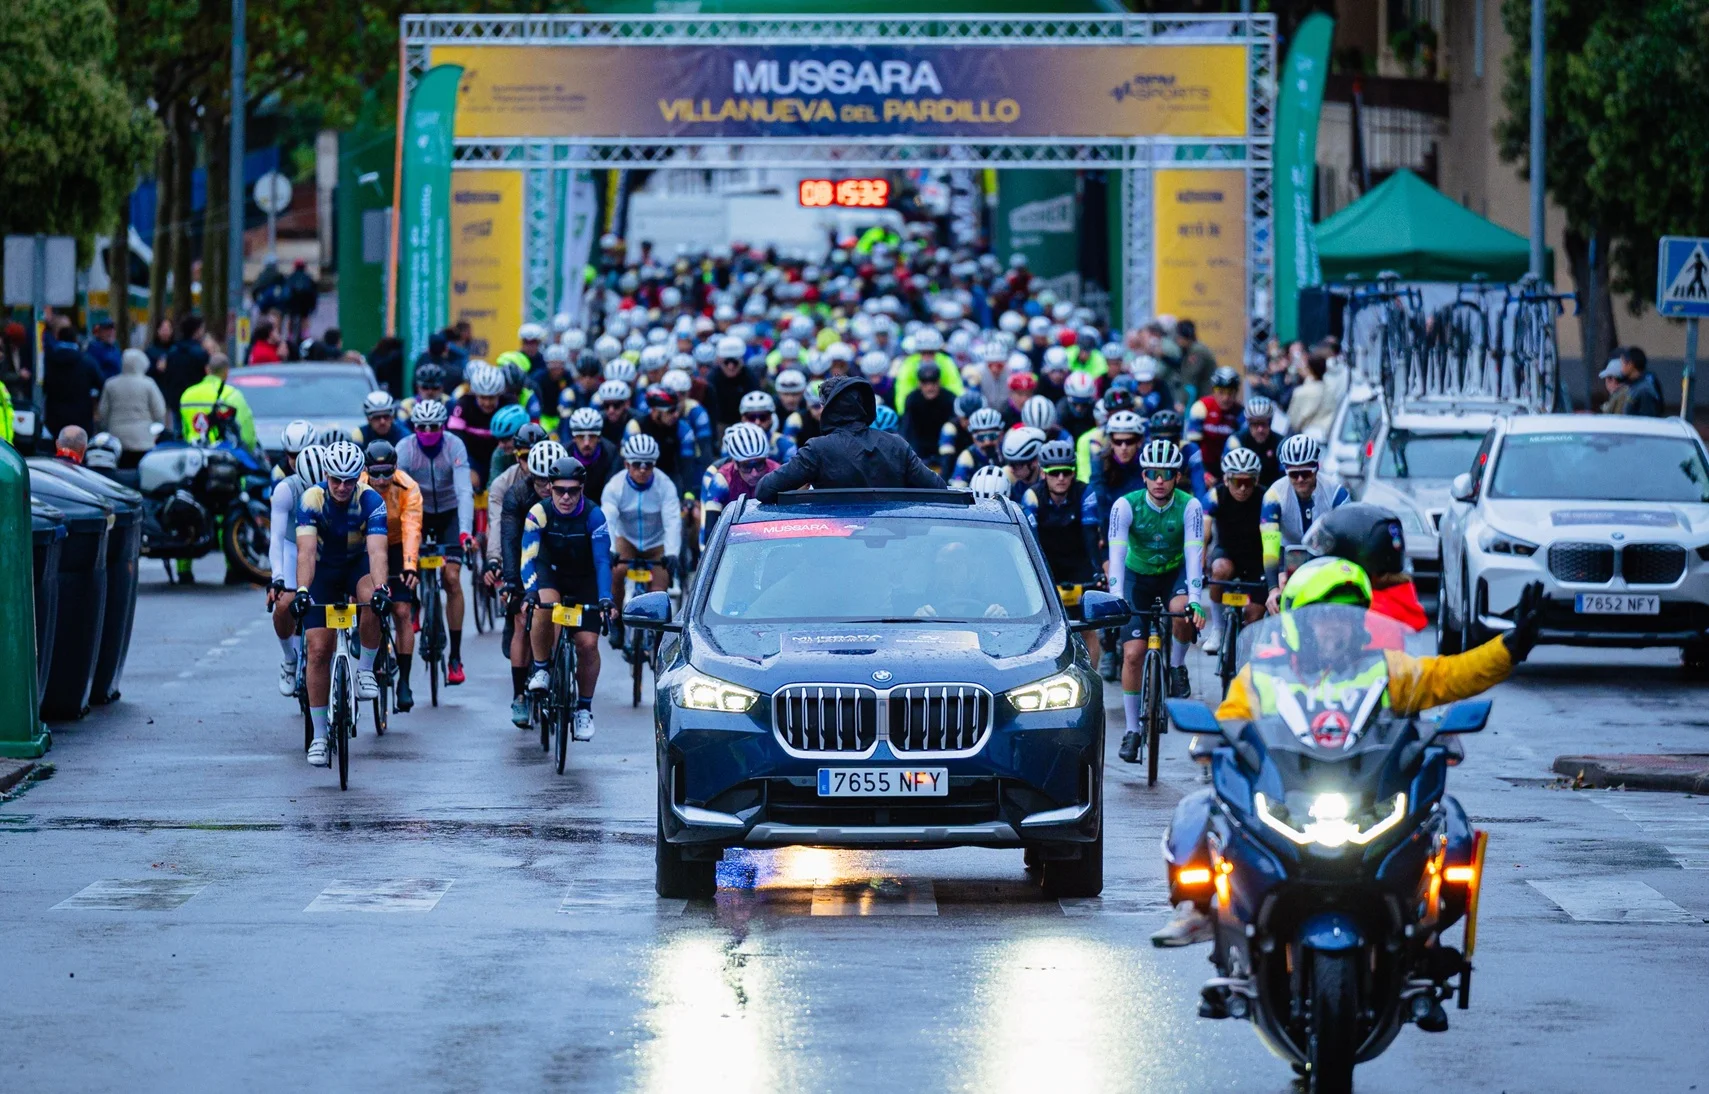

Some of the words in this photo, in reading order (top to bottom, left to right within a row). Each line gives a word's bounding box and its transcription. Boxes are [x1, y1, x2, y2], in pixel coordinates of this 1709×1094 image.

[733, 60, 943, 95] MUSSARA
[658, 98, 836, 123] VILLANUEVA
[840, 105, 879, 123] DEL
[883, 98, 1021, 123] PARDILLO
[763, 523, 830, 534] MUSSARA
[1585, 596, 1622, 611] 7652
[1627, 597, 1655, 611] NFY
[834, 772, 891, 793] 7655
[899, 771, 941, 793] NFY
